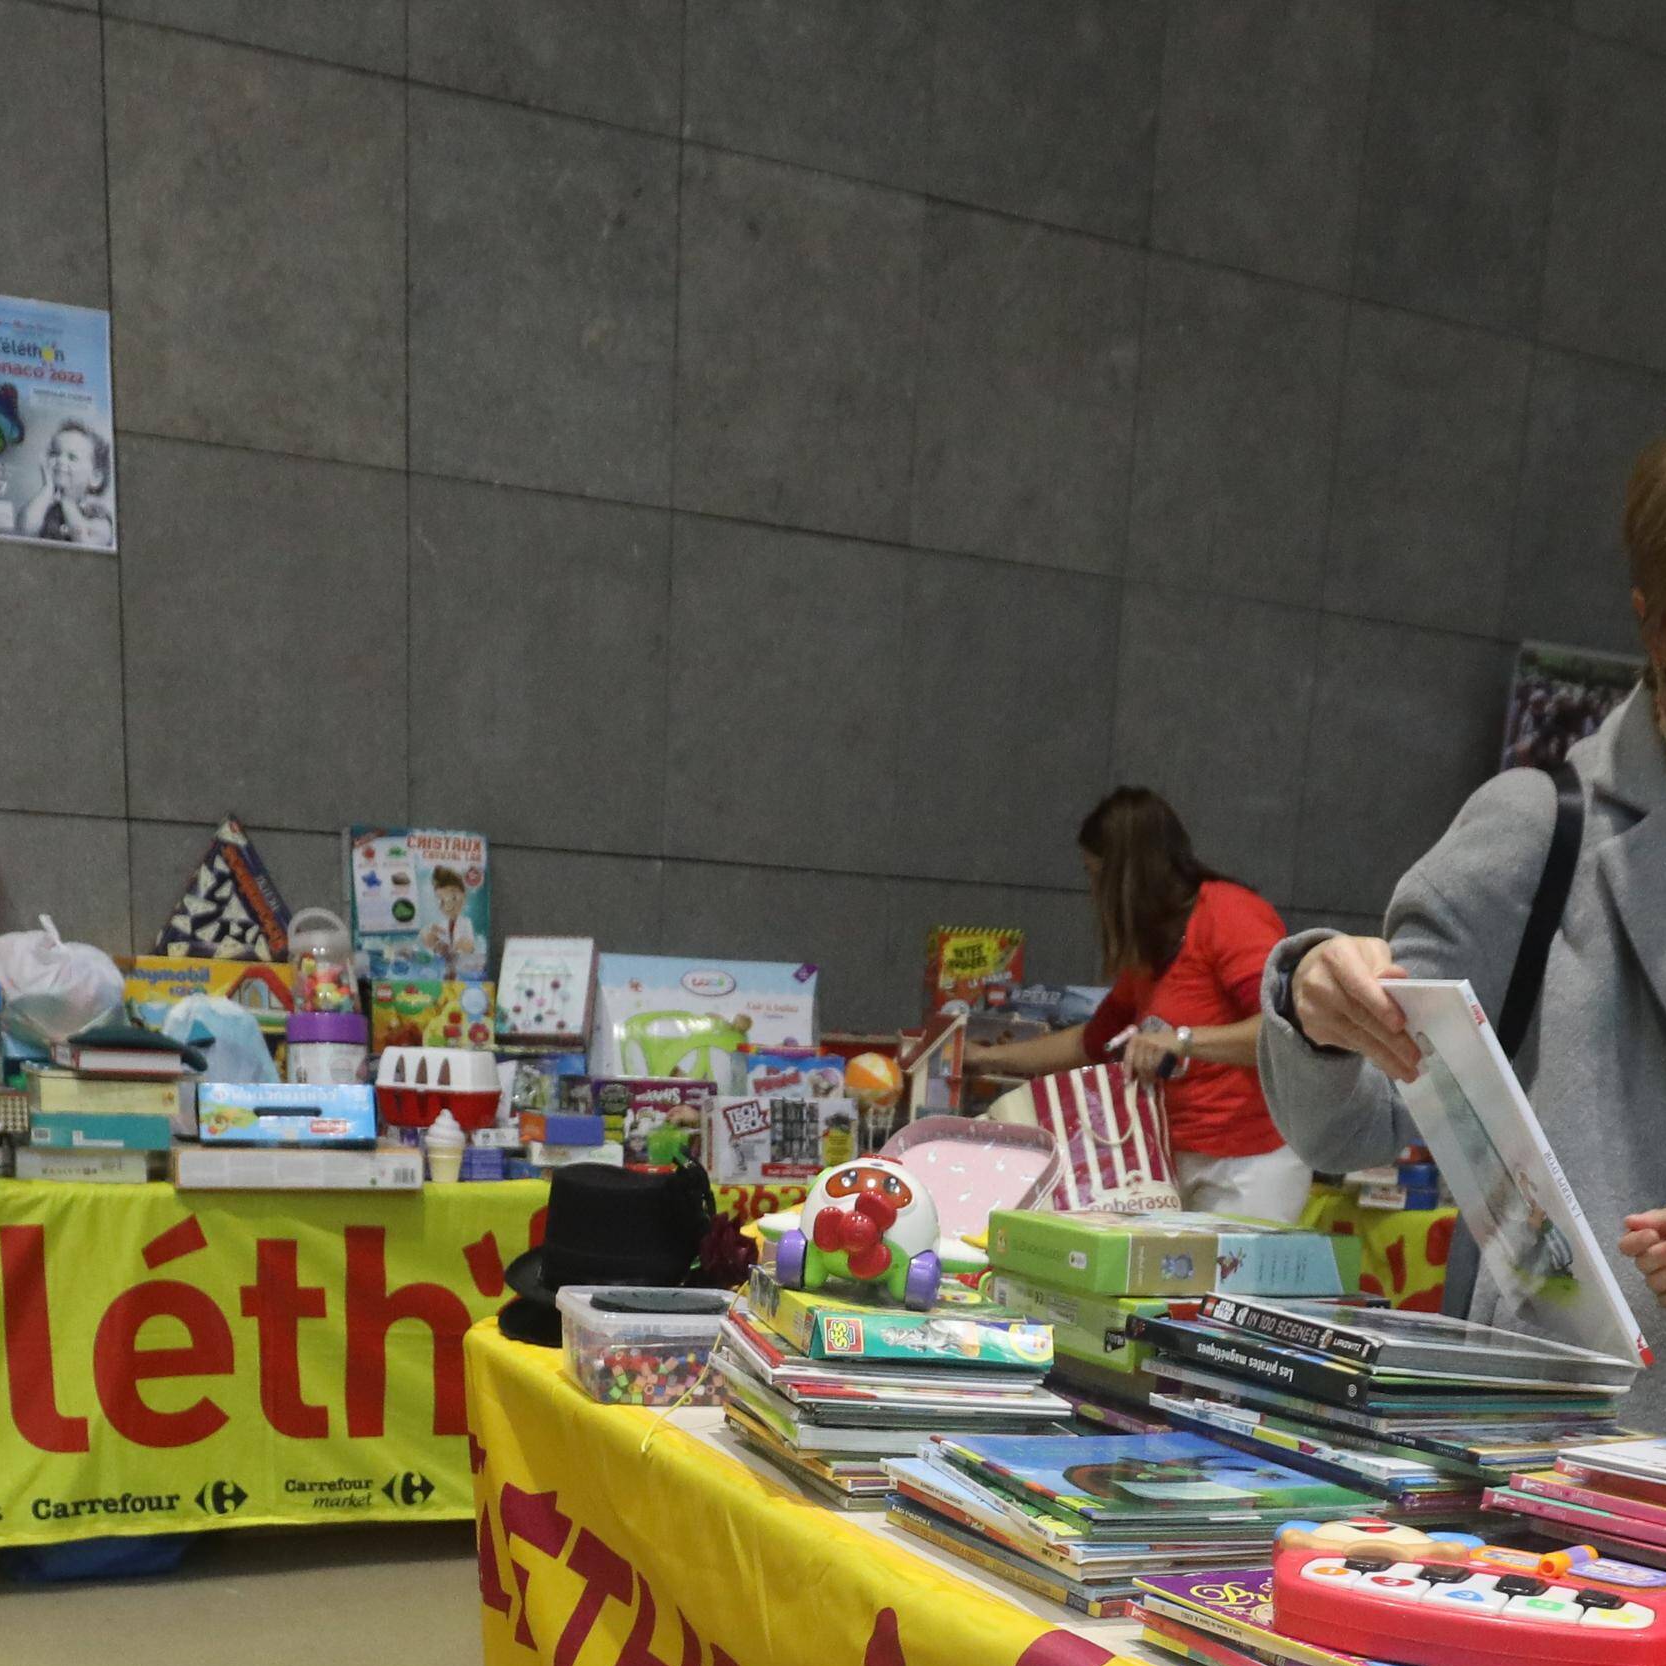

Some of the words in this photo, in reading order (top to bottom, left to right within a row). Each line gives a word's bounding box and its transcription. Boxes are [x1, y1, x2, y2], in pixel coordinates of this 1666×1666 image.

[50, 367, 85, 385] 2022
[728, 1103, 759, 1121] TECH
[733, 1114, 769, 1136] DECK
[1246, 1312, 1259, 1327] IN
[1260, 1314, 1277, 1331] 100
[1277, 1320, 1319, 1343] SCENES
[1197, 1342, 1247, 1368] magnétiques
[1248, 1358, 1278, 1380] pirates
[1277, 1367, 1295, 1382] Les
[285, 1477, 373, 1494] Carrefour
[33, 1491, 179, 1522] Carrefour
[313, 1491, 372, 1509] market
